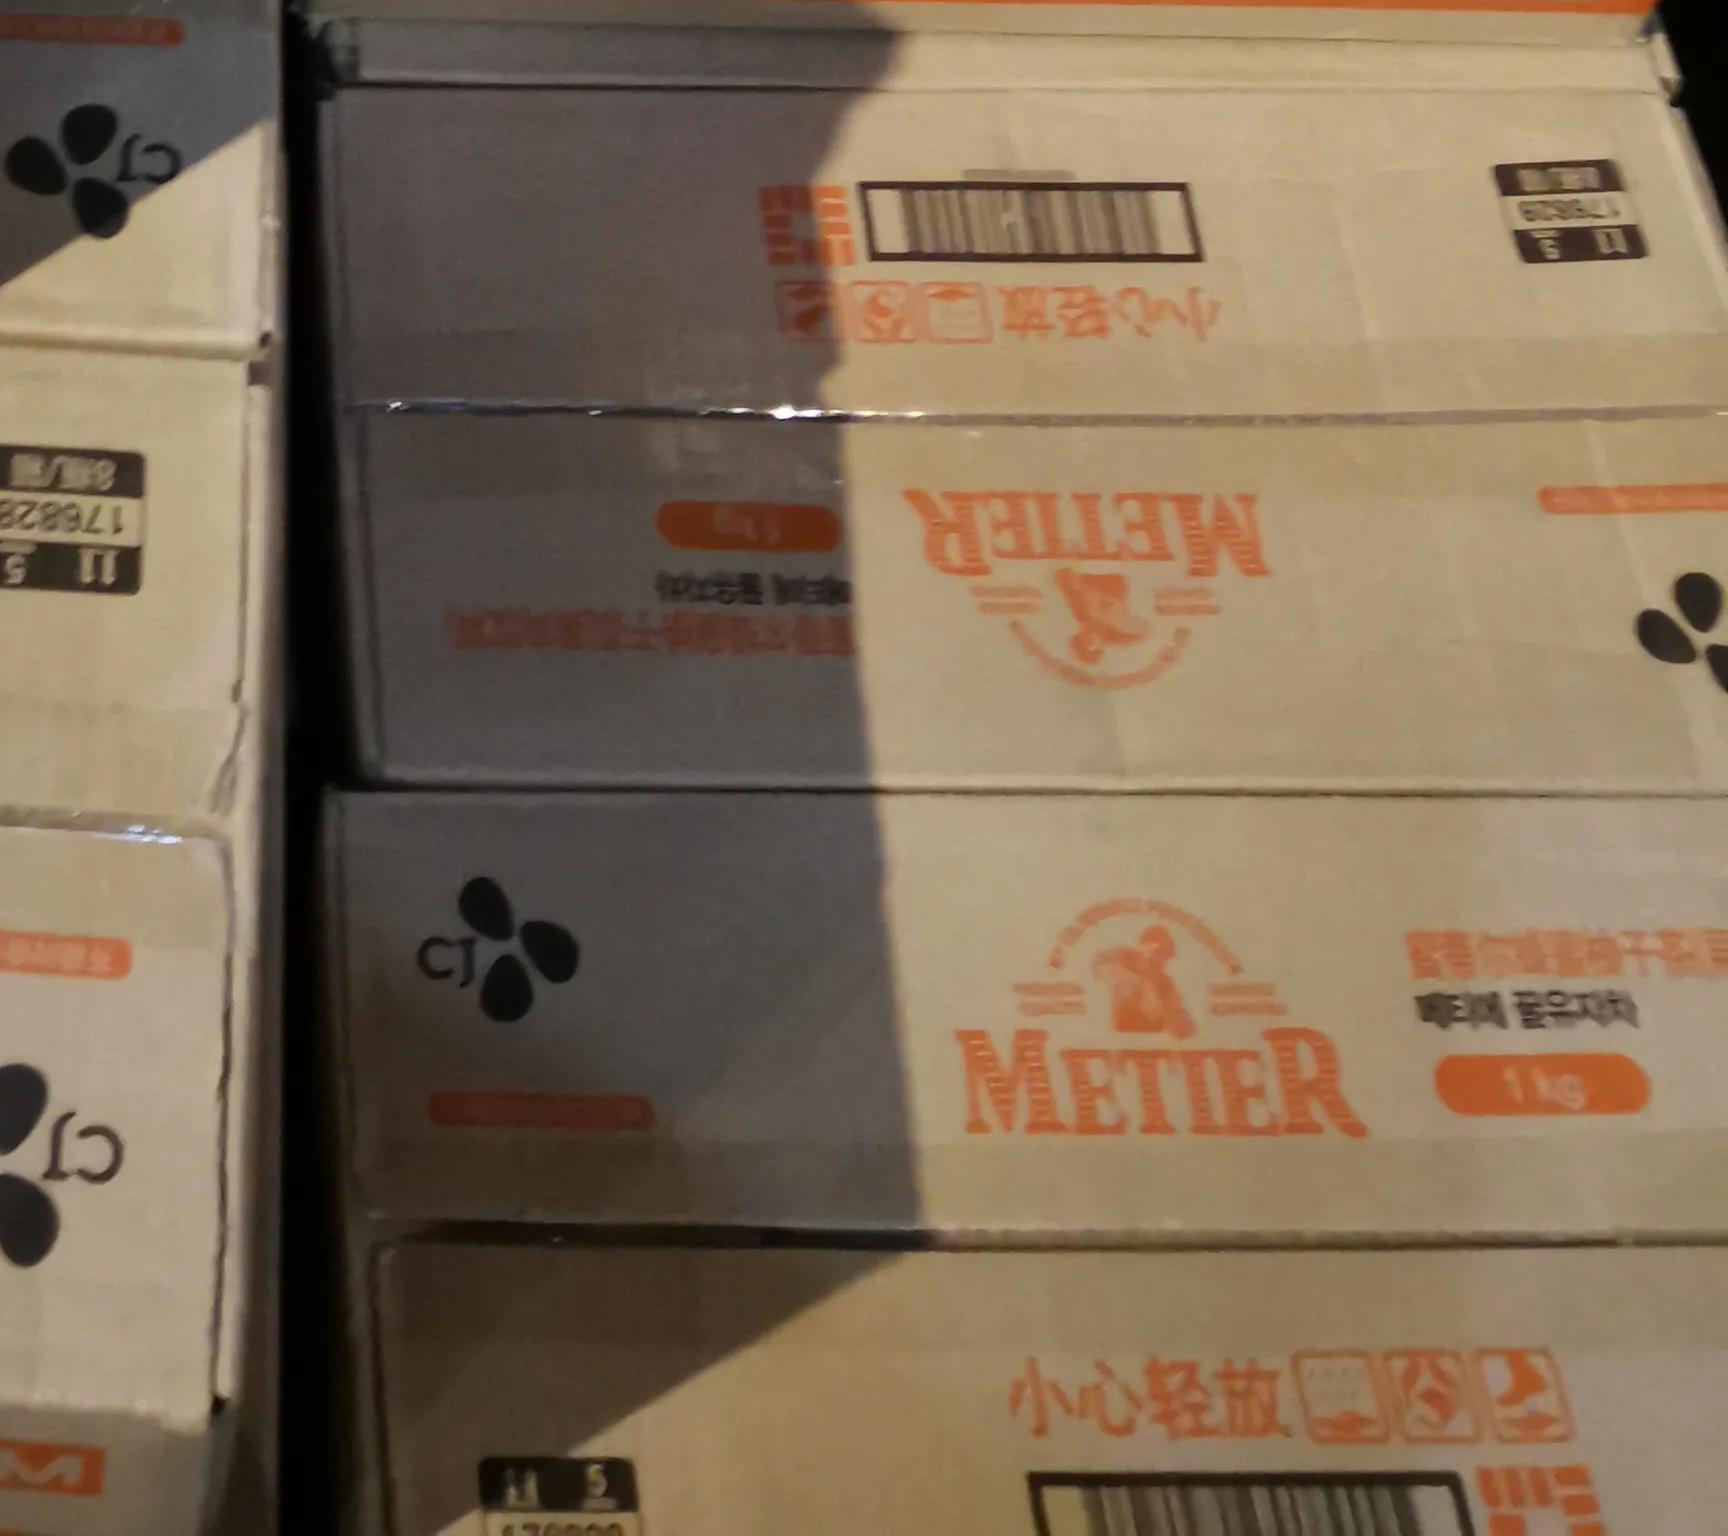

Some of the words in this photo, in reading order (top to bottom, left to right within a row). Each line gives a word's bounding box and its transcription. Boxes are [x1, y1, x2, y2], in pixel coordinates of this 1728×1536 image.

[118, 132, 182, 185] CJ
[996, 284, 1220, 343] 小心轻放
[902, 488, 1270, 578] METIER
[416, 934, 478, 989] CJ
[954, 1026, 1368, 1139] METIER
[42, 1110, 125, 1185] CJ
[1008, 1356, 1292, 1440] 小心轻放
